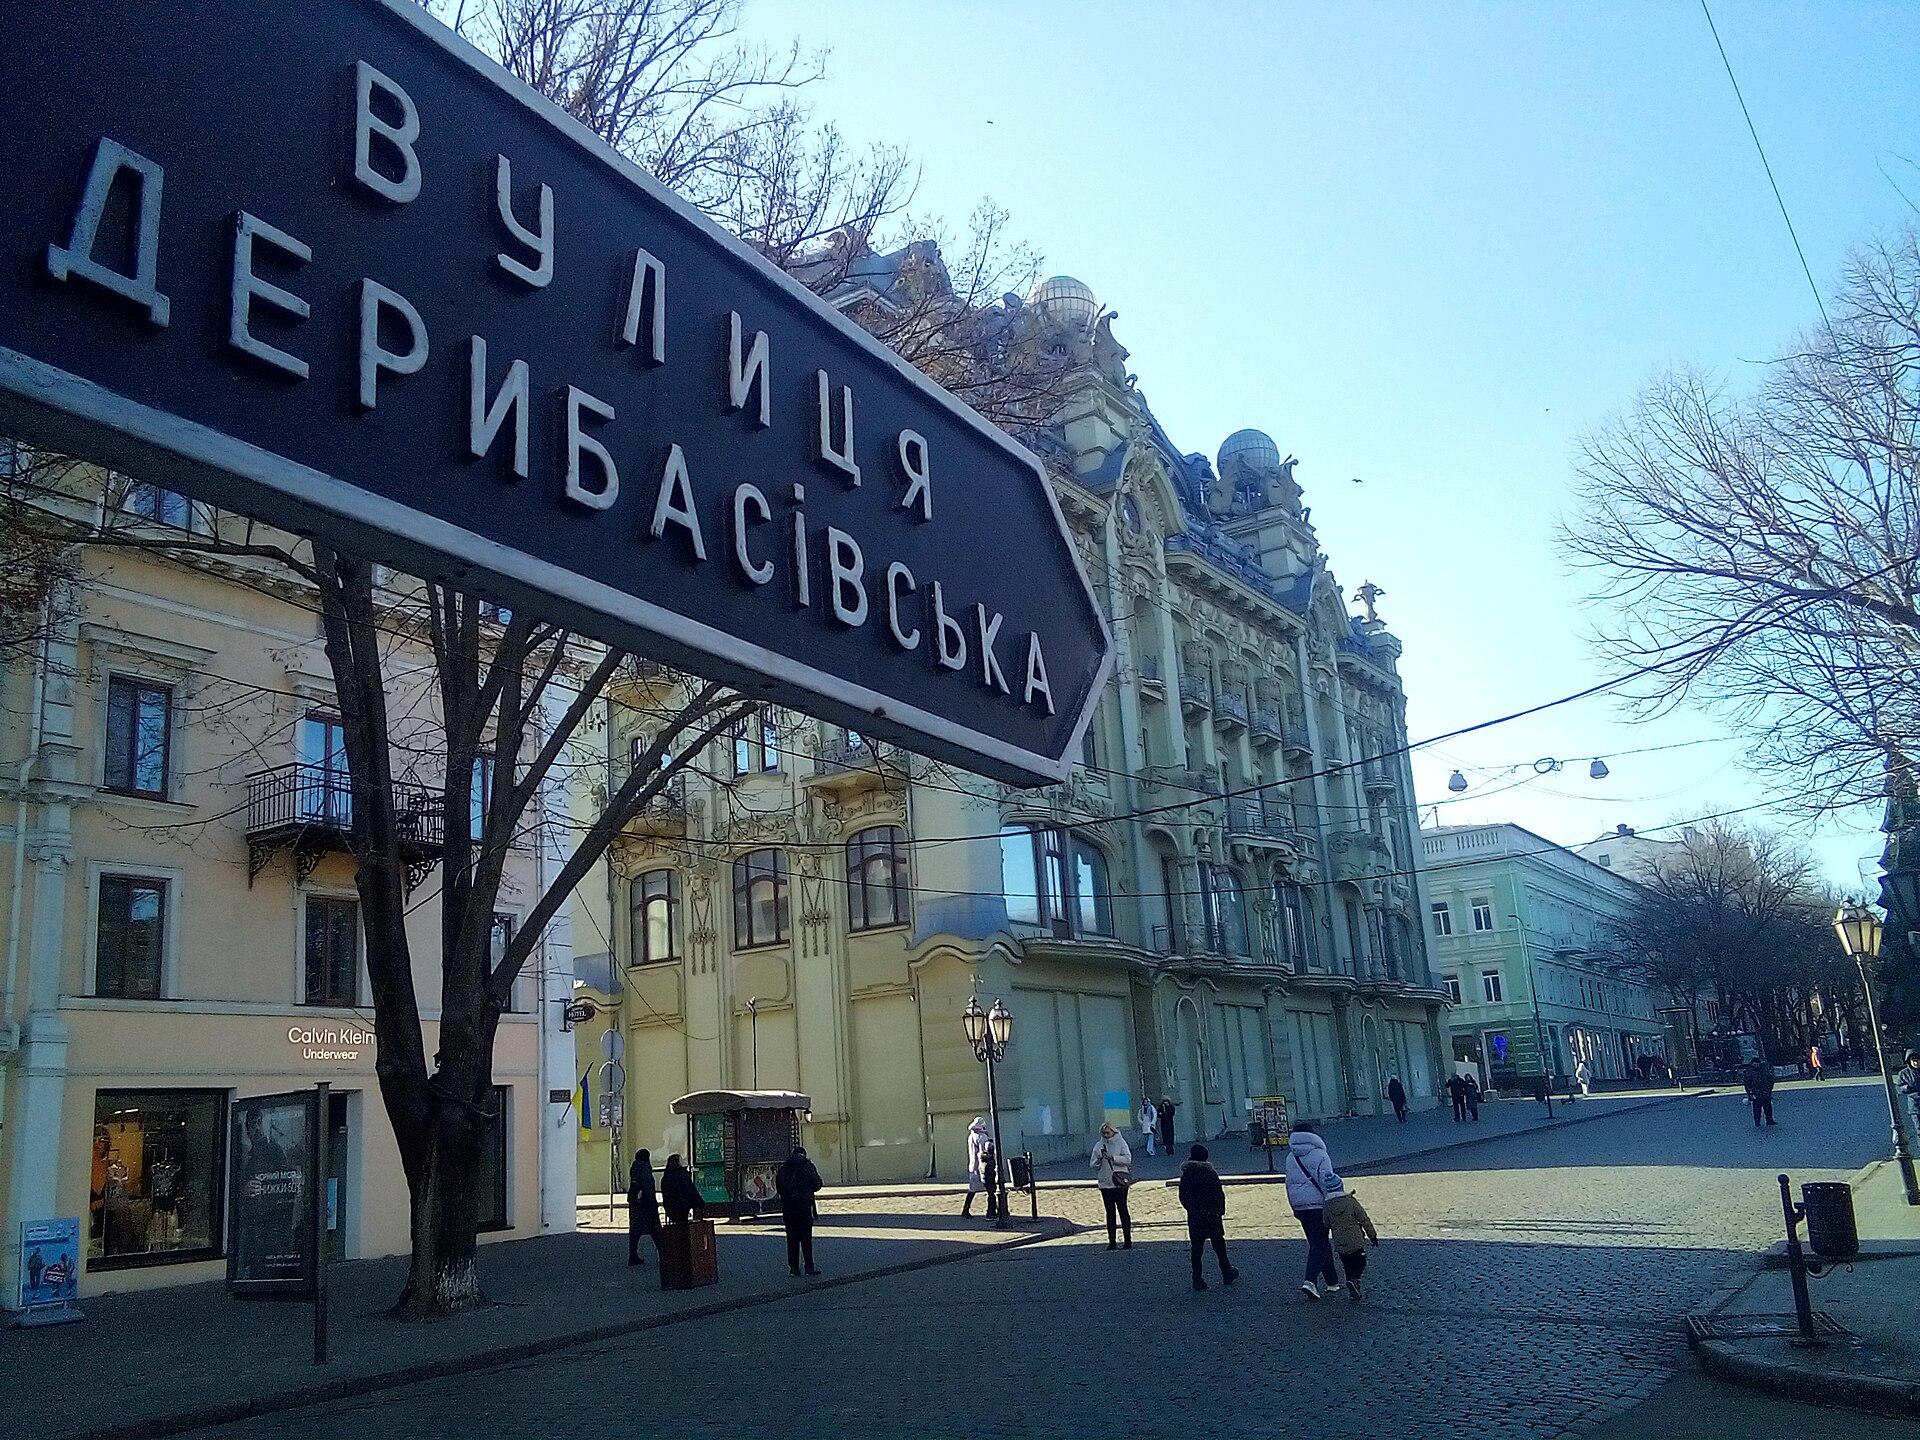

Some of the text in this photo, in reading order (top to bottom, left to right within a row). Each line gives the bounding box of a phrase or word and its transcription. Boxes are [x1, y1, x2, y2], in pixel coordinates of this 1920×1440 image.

[354, 60, 934, 522] ВУЛИЦЯ
[288, 1027, 374, 1045] Calvin Klein
[303, 1048, 359, 1060] Underwear
